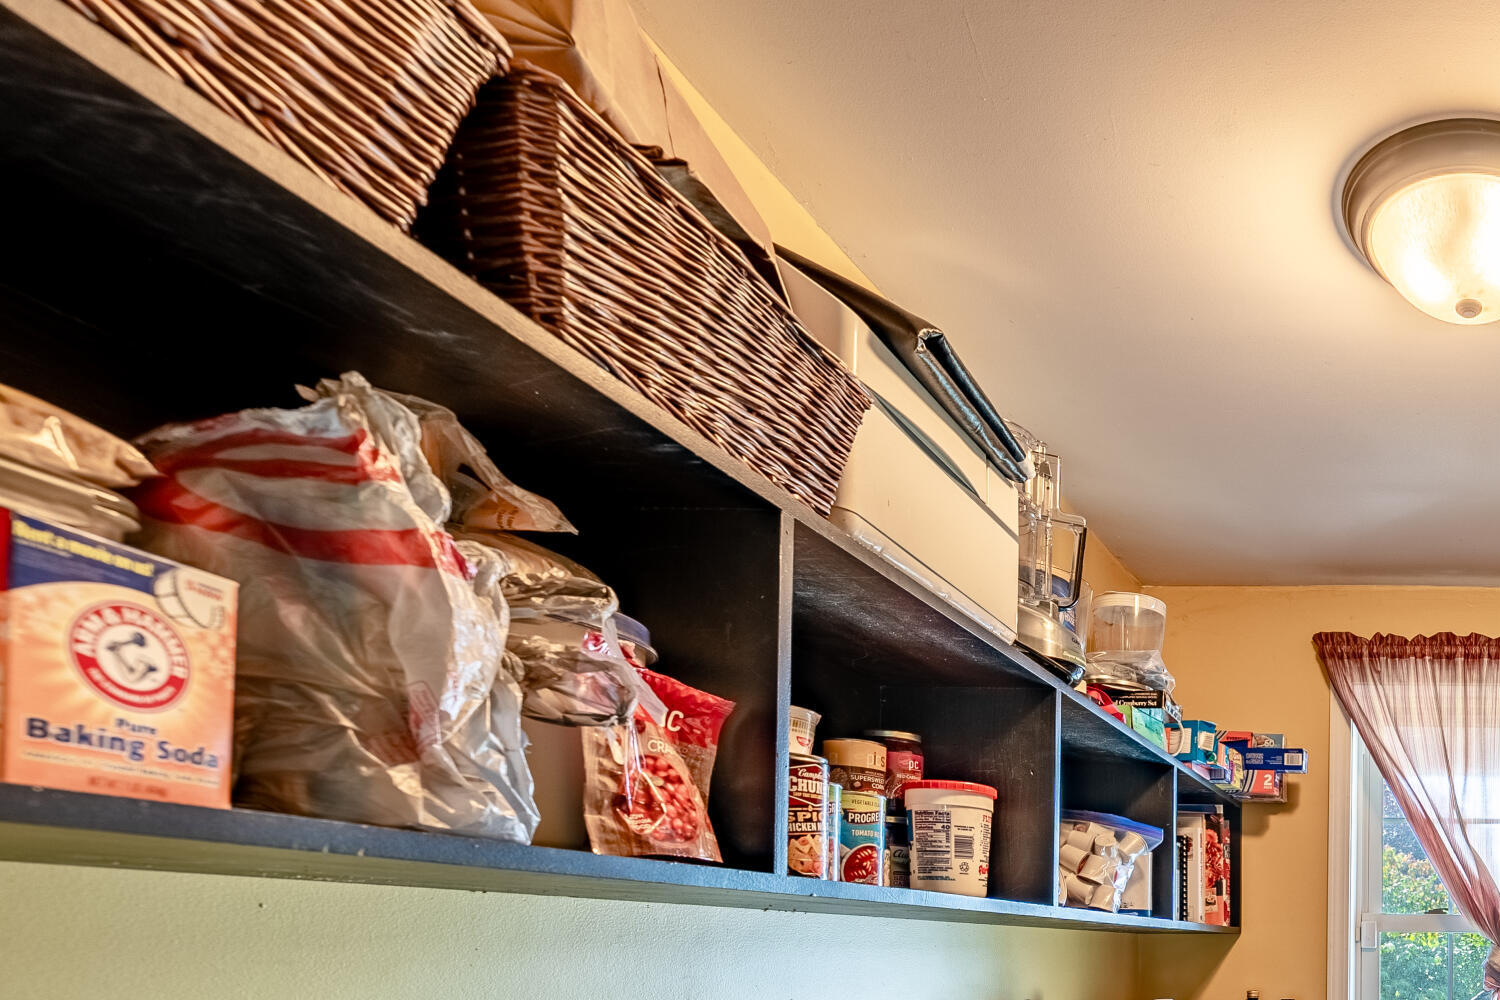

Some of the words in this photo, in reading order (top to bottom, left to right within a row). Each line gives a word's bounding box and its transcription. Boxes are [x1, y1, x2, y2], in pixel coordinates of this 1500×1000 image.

[26, 716, 146, 761] Baking
[157, 740, 219, 768] Soda
[909, 759, 919, 771] pc
[1263, 774, 1273, 786] 2
[848, 811, 880, 824] PROGRE
[788, 822, 816, 832] HICKEN
